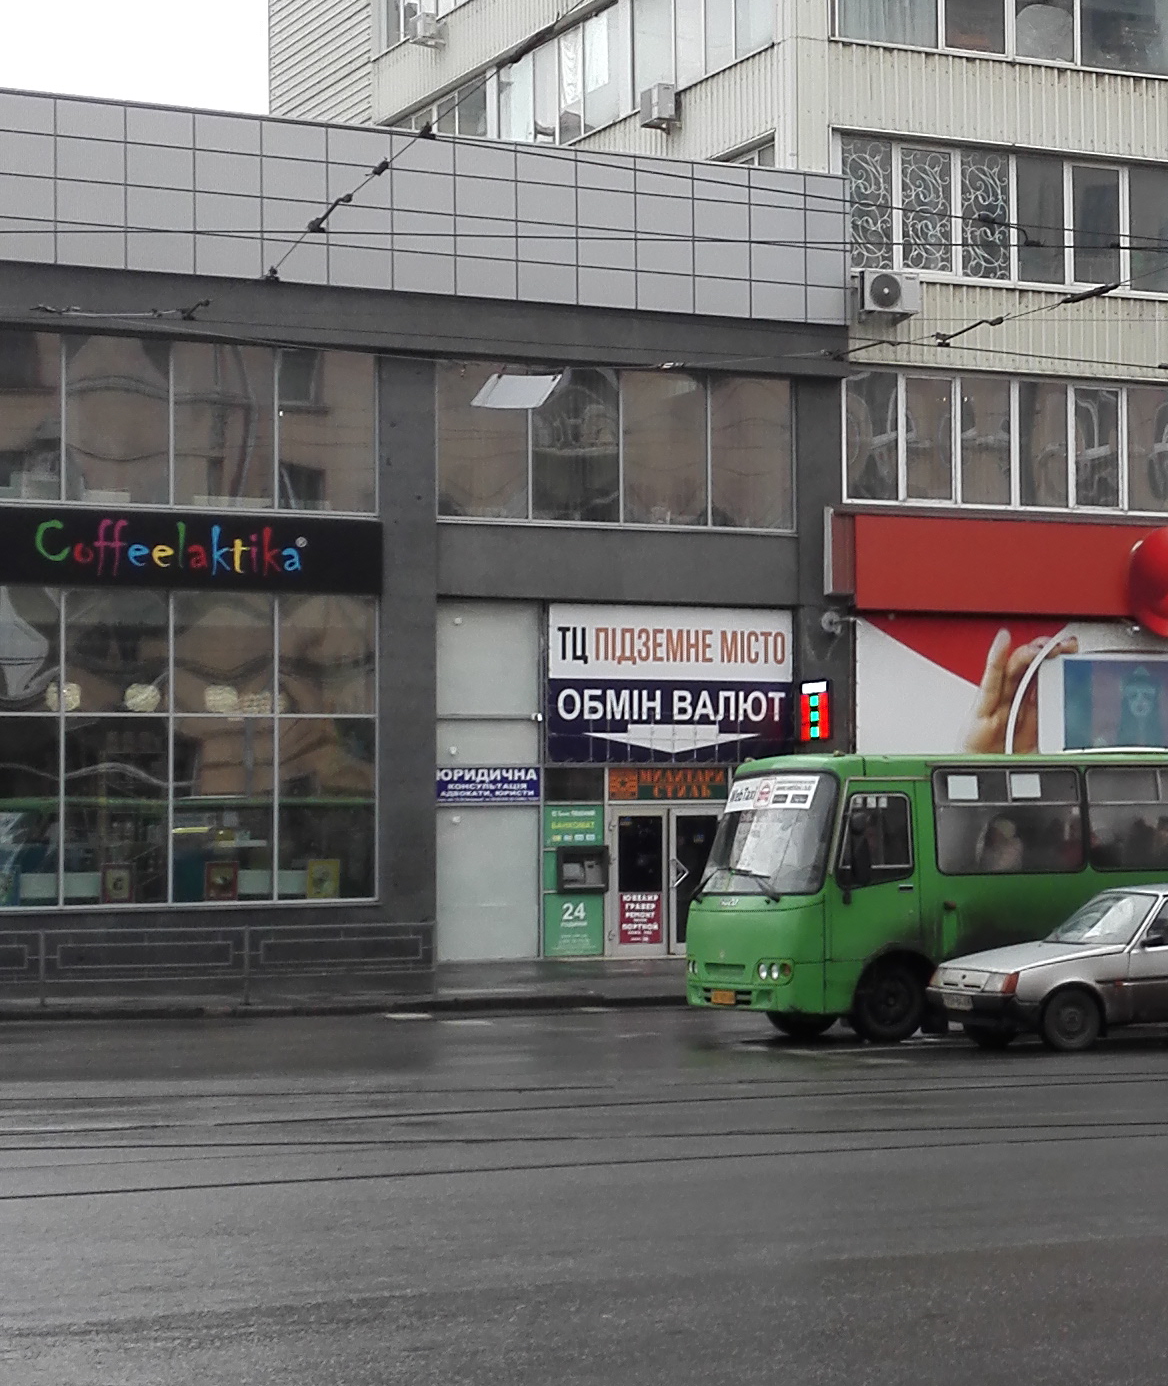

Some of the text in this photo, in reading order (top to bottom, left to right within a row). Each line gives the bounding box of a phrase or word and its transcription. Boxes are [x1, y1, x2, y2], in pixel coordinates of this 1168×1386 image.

[35, 519, 301, 576] Coffeelaktika
[558, 626, 785, 665] ТЦ ПІДЗЕМНЕ МІСТО
[557, 688, 786, 722] ОБМІН ВАЛЮТ
[436, 768, 538, 783] ЮРИДИЧНА
[447, 782, 528, 790] КОНСУЛЬТАЦІЯ
[562, 902, 586, 920] 24
